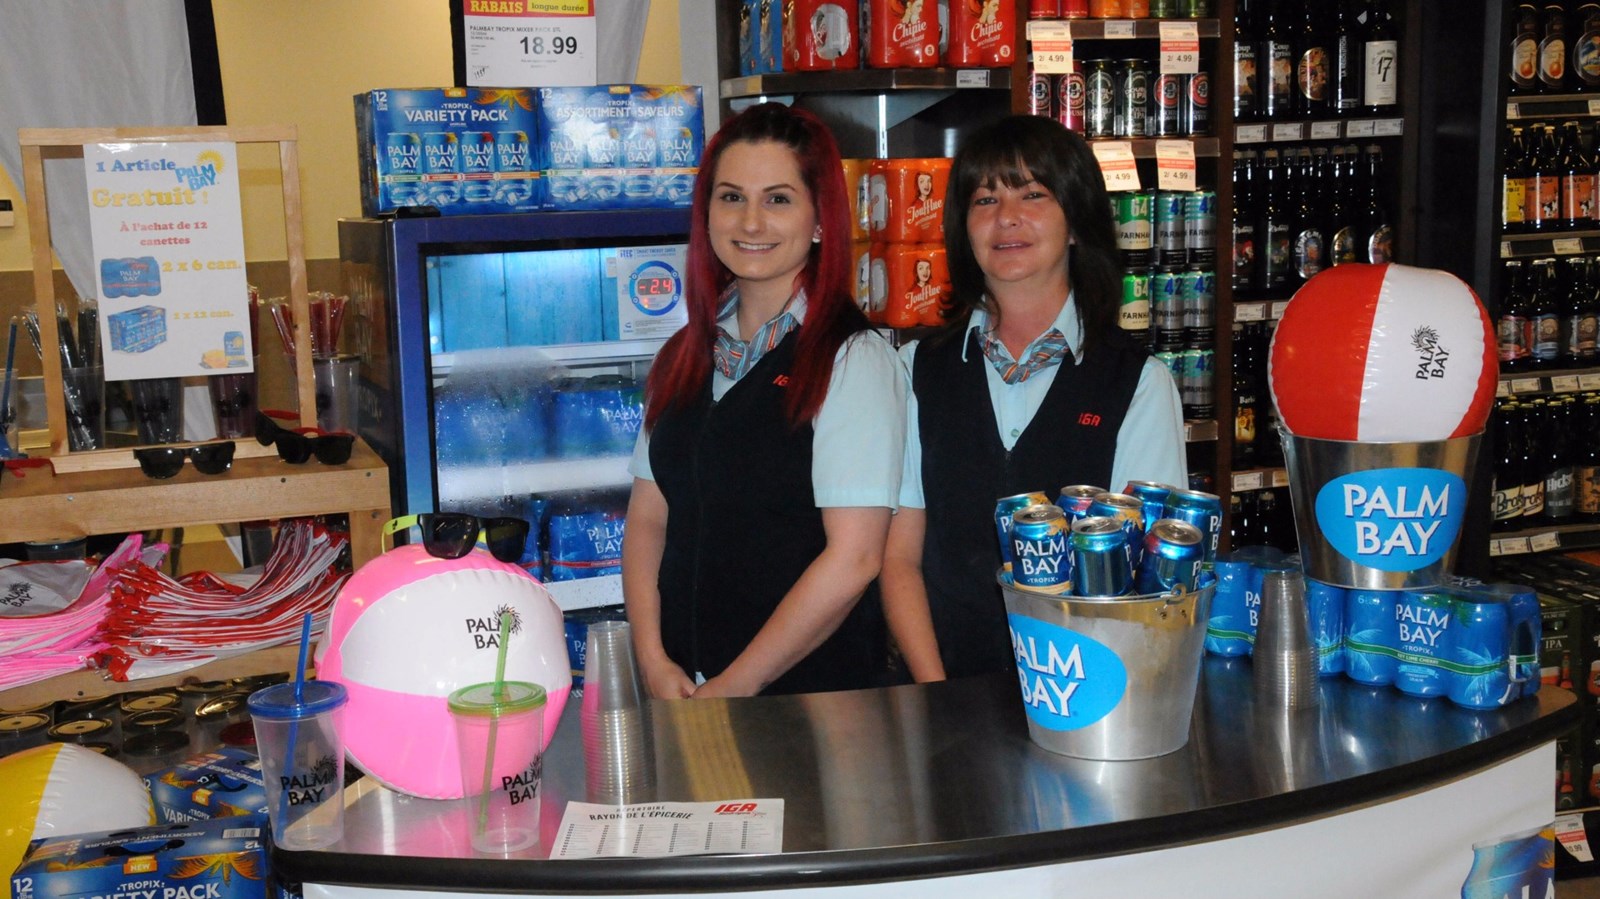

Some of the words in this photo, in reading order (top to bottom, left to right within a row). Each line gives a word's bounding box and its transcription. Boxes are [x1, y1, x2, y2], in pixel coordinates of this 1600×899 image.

[470, 0, 523, 14] RABAIS
[531, 2, 559, 12] longue
[892, 20, 927, 42] Chipie
[971, 21, 1003, 42] Chipie
[520, 36, 577, 55] 18.99
[1048, 54, 1064, 62] 4.99
[1177, 54, 1192, 62] 4.99
[1377, 56, 1393, 82] 17
[374, 91, 387, 102] 12
[540, 88, 553, 99] 12
[404, 109, 468, 122] VARIETY
[471, 109, 508, 121] PACK
[557, 107, 631, 117] ASSORTIMENT
[638, 106, 684, 116] SAVEURS
[387, 145, 421, 156] PALM
[425, 144, 457, 156] PALM
[461, 144, 494, 155] PALM
[497, 143, 529, 155] PALM
[660, 139, 691, 150] PALM
[392, 157, 418, 169] BAY
[429, 156, 456, 168] BAY
[465, 156, 492, 167] BAY
[501, 155, 527, 166] BAY
[664, 151, 690, 161] BAY
[111, 158, 176, 172] Article
[175, 163, 216, 184] PALM
[1173, 171, 1188, 179] 4.99
[188, 176, 217, 191] BAY
[91, 186, 197, 208] Gratuit
[1131, 198, 1148, 217] 64
[177, 221, 191, 230] de
[193, 221, 208, 230] 12
[140, 236, 191, 246] canettes
[1164, 278, 1184, 295] 42
[1416, 338, 1438, 380] PALM
[1430, 345, 1450, 378] BAY
[773, 374, 789, 386] IG
[1078, 412, 1101, 426] IGA
[1343, 483, 1450, 518] PALM
[1355, 520, 1442, 556] BAY
[1014, 538, 1065, 557] PALM
[1021, 555, 1064, 575] BAY
[11, 593, 33, 607] BAY
[1395, 604, 1450, 630] PALM
[1399, 623, 1443, 647] BAY
[1545, 639, 1562, 649] IPA
[1019, 672, 1080, 718] BAY
[280, 773, 331, 791] PALM
[502, 769, 541, 791] PALM
[288, 787, 326, 806] BAY
[509, 783, 539, 806] BAY
[714, 803, 758, 813] IGA
[589, 812, 624, 821] RAYON
[626, 812, 638, 820] DE
[130, 863, 150, 873] NEW
[13, 877, 33, 893] 12
[120, 880, 162, 891] TROPIX
[164, 883, 221, 899] PACK
